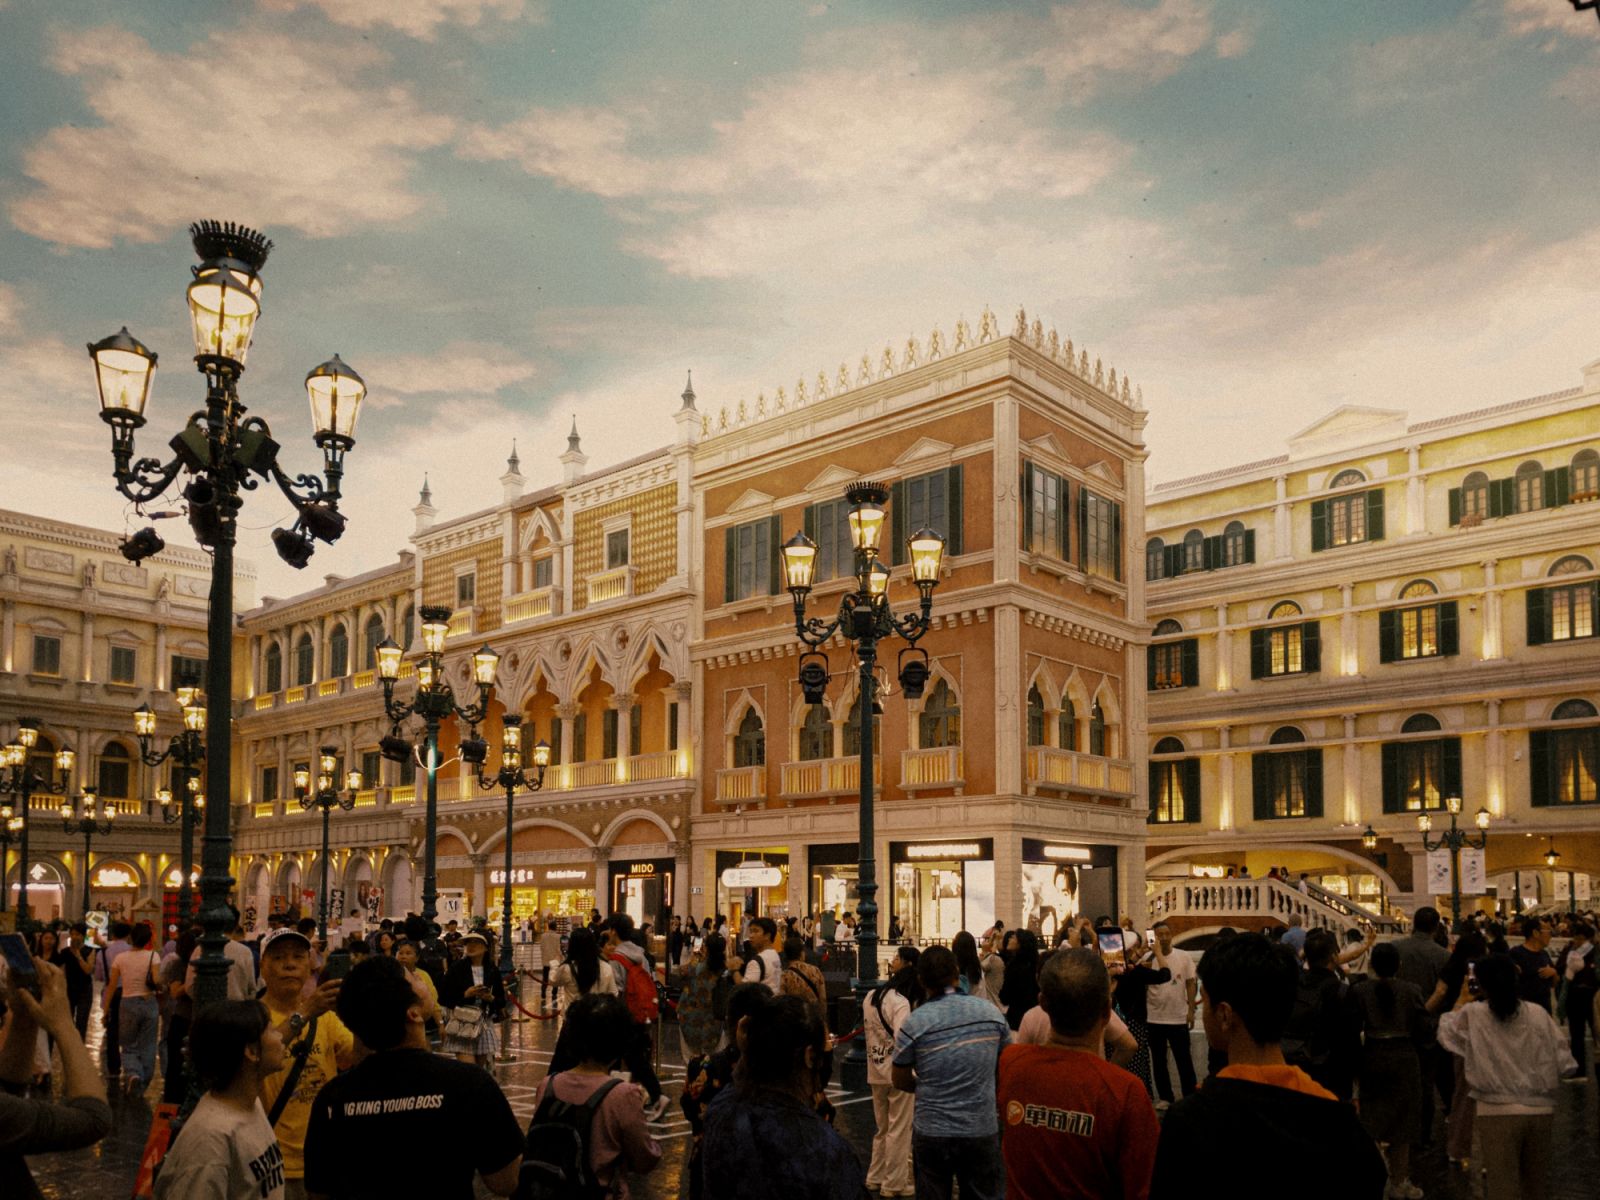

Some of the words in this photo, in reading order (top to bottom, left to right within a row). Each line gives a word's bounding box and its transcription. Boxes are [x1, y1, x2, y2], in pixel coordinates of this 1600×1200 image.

[631, 863, 654, 873] MIDO
[356, 1101, 381, 1115] KING
[383, 1096, 416, 1113] YOUNG
[416, 1094, 444, 1109] BOSS
